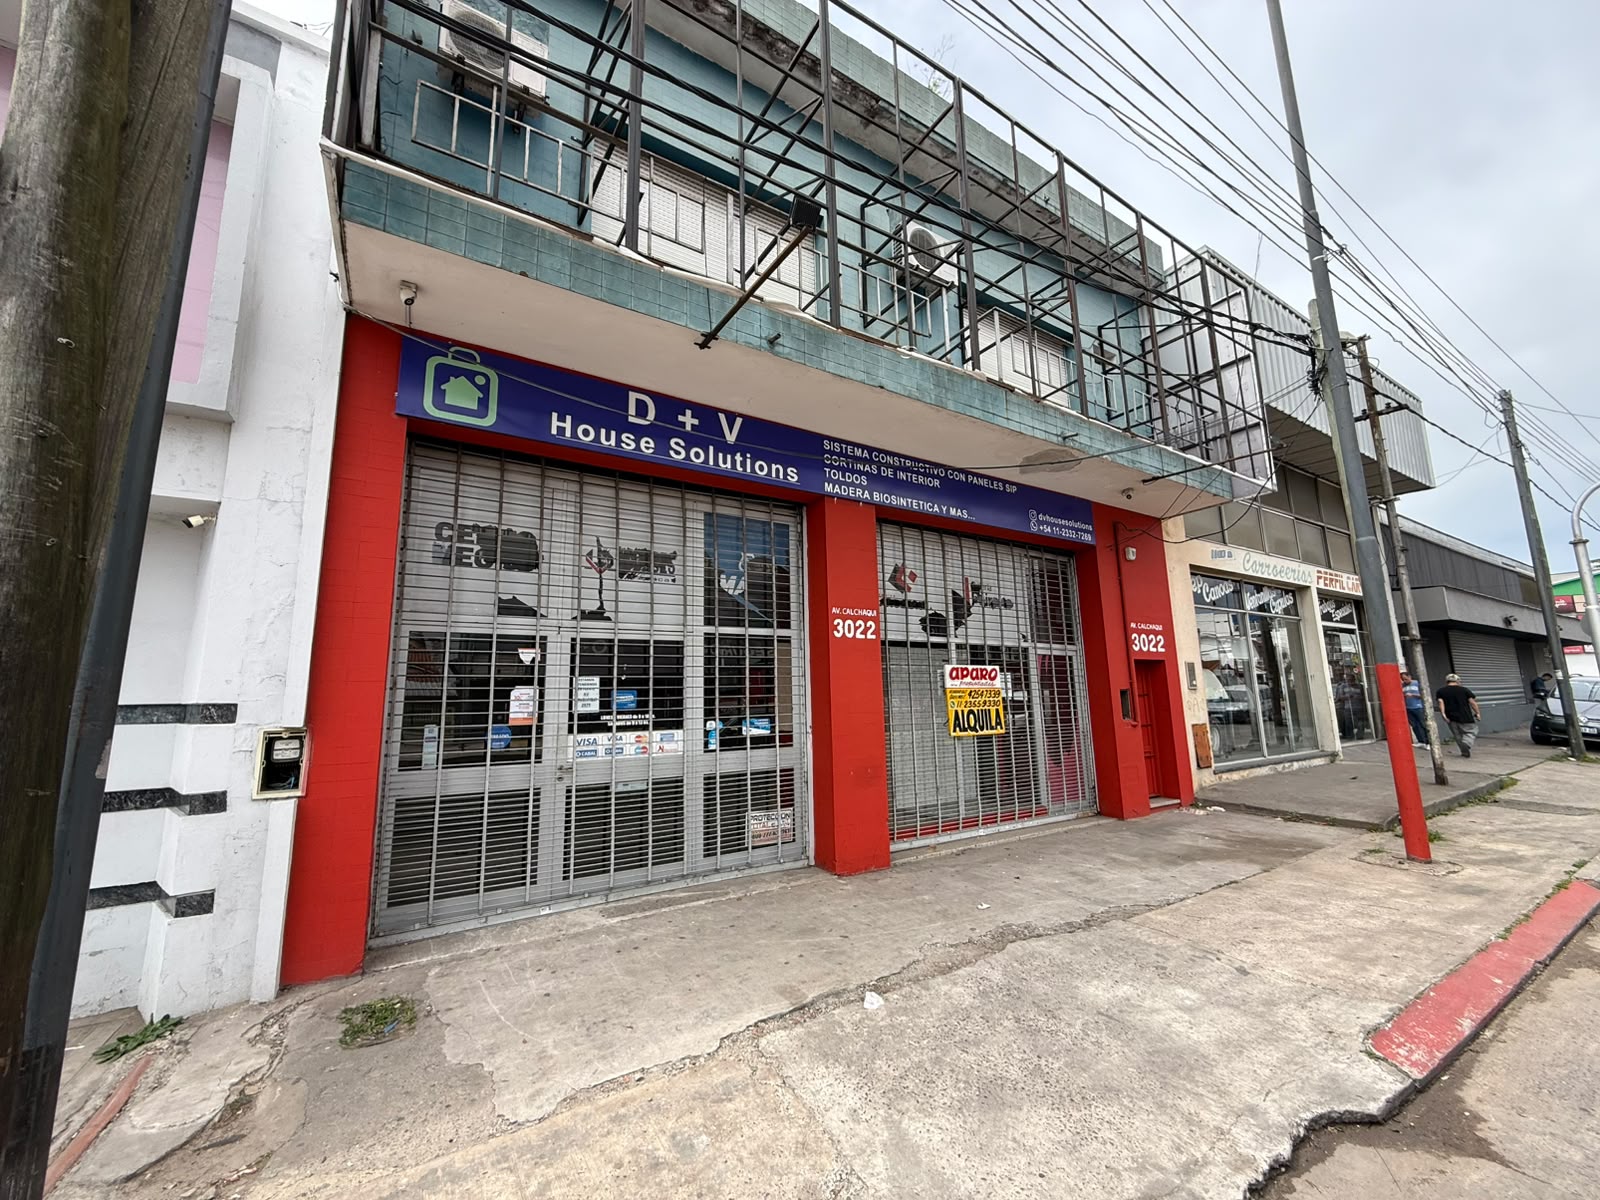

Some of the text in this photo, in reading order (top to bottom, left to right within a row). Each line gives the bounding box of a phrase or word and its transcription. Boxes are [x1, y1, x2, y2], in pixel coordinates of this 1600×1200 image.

[628, 390, 656, 425] D
[718, 412, 743, 444] V
[551, 411, 799, 482] House Solutions
[823, 439, 1017, 494] SISTEMA CONSTRUCTIVO CON PANELES SIP
[823, 454, 941, 489] CORTINAS DE INTERIOR
[823, 467, 868, 486] TOLDOS
[824, 481, 871, 500] MADERA
[873, 491, 940, 513] BIOSINTETICA
[941, 505, 948, 514] Y
[1038, 513, 1093, 531] dvhousesolutions
[1039, 524, 1051, 533] +54
[831, 606, 877, 617] AV. CALCHAQUI
[833, 618, 877, 640] 3022
[1131, 633, 1166, 652] 3022
[952, 708, 1004, 733] ALQUILA
[576, 737, 598, 746] VISA
